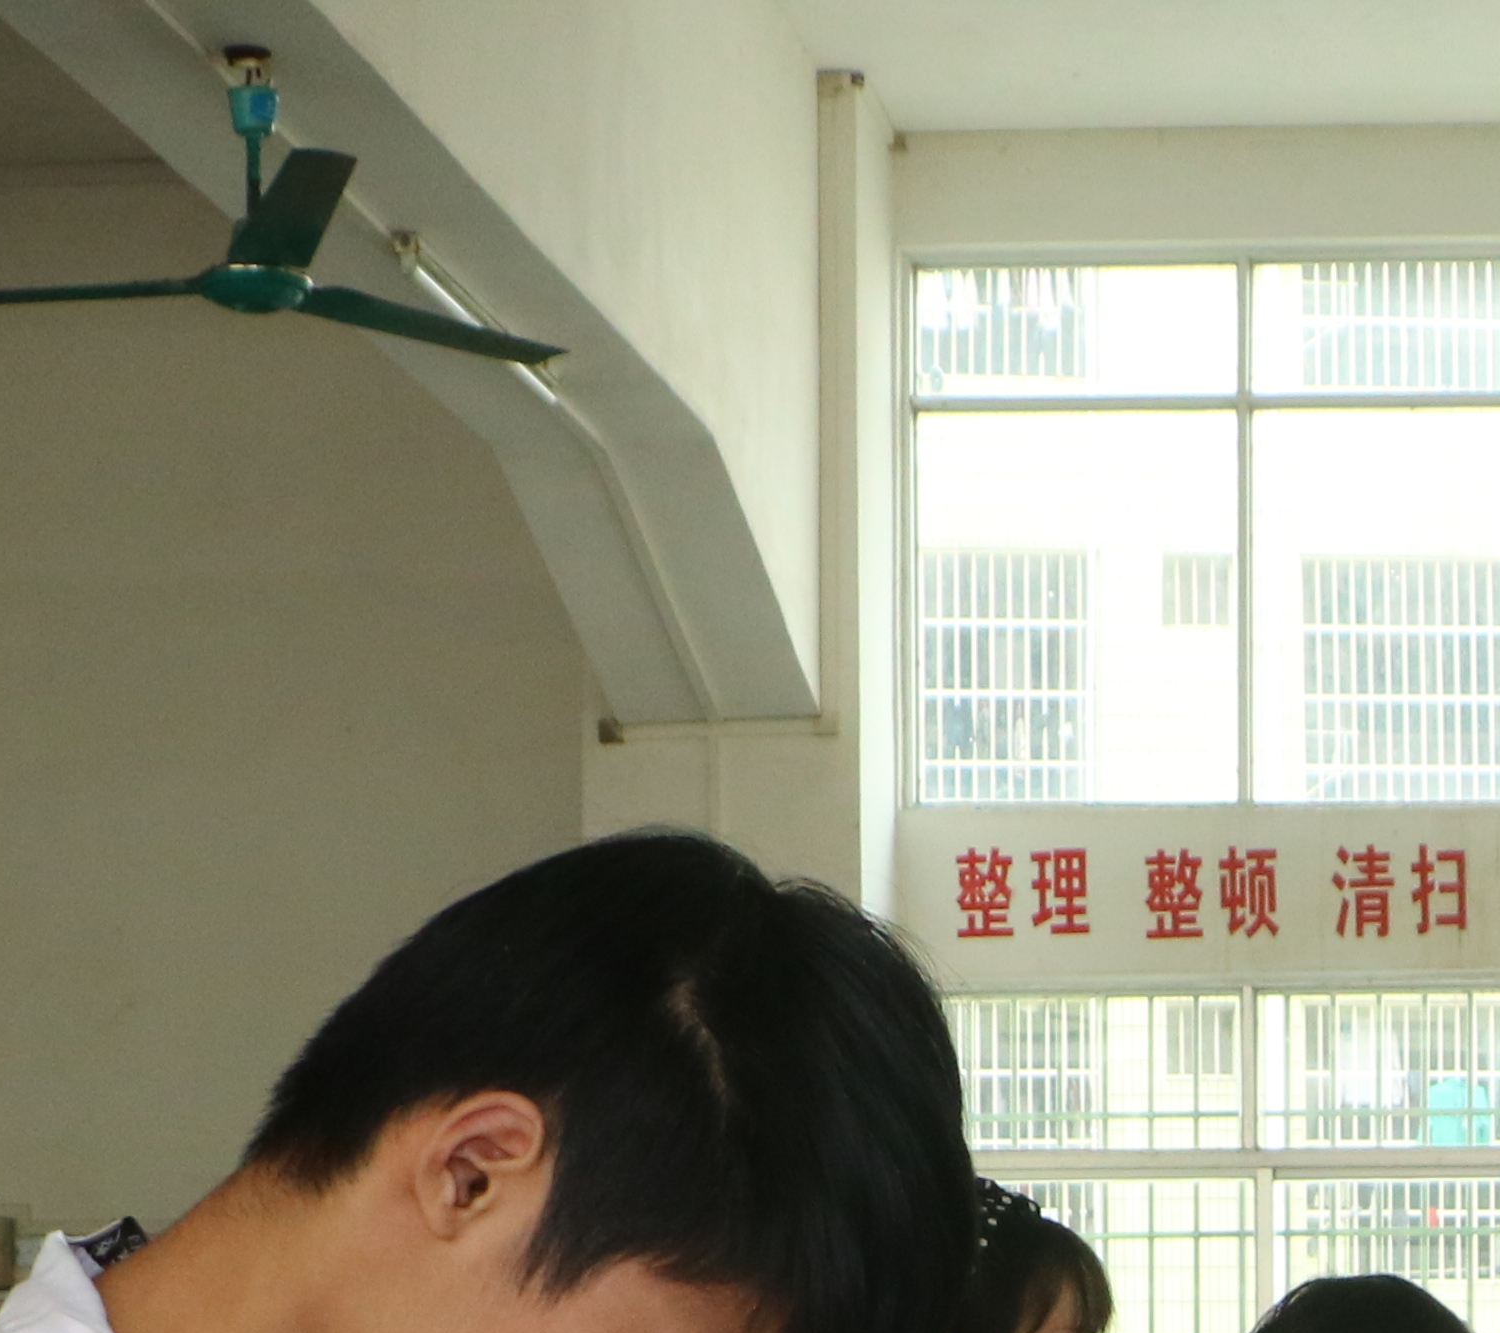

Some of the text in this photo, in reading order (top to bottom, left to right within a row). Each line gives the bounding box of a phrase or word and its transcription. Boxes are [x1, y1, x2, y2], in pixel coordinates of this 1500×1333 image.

[957, 848, 1090, 938] 整理
[1146, 847, 1278, 939] 整顿
[1333, 845, 1467, 937] 清扫
